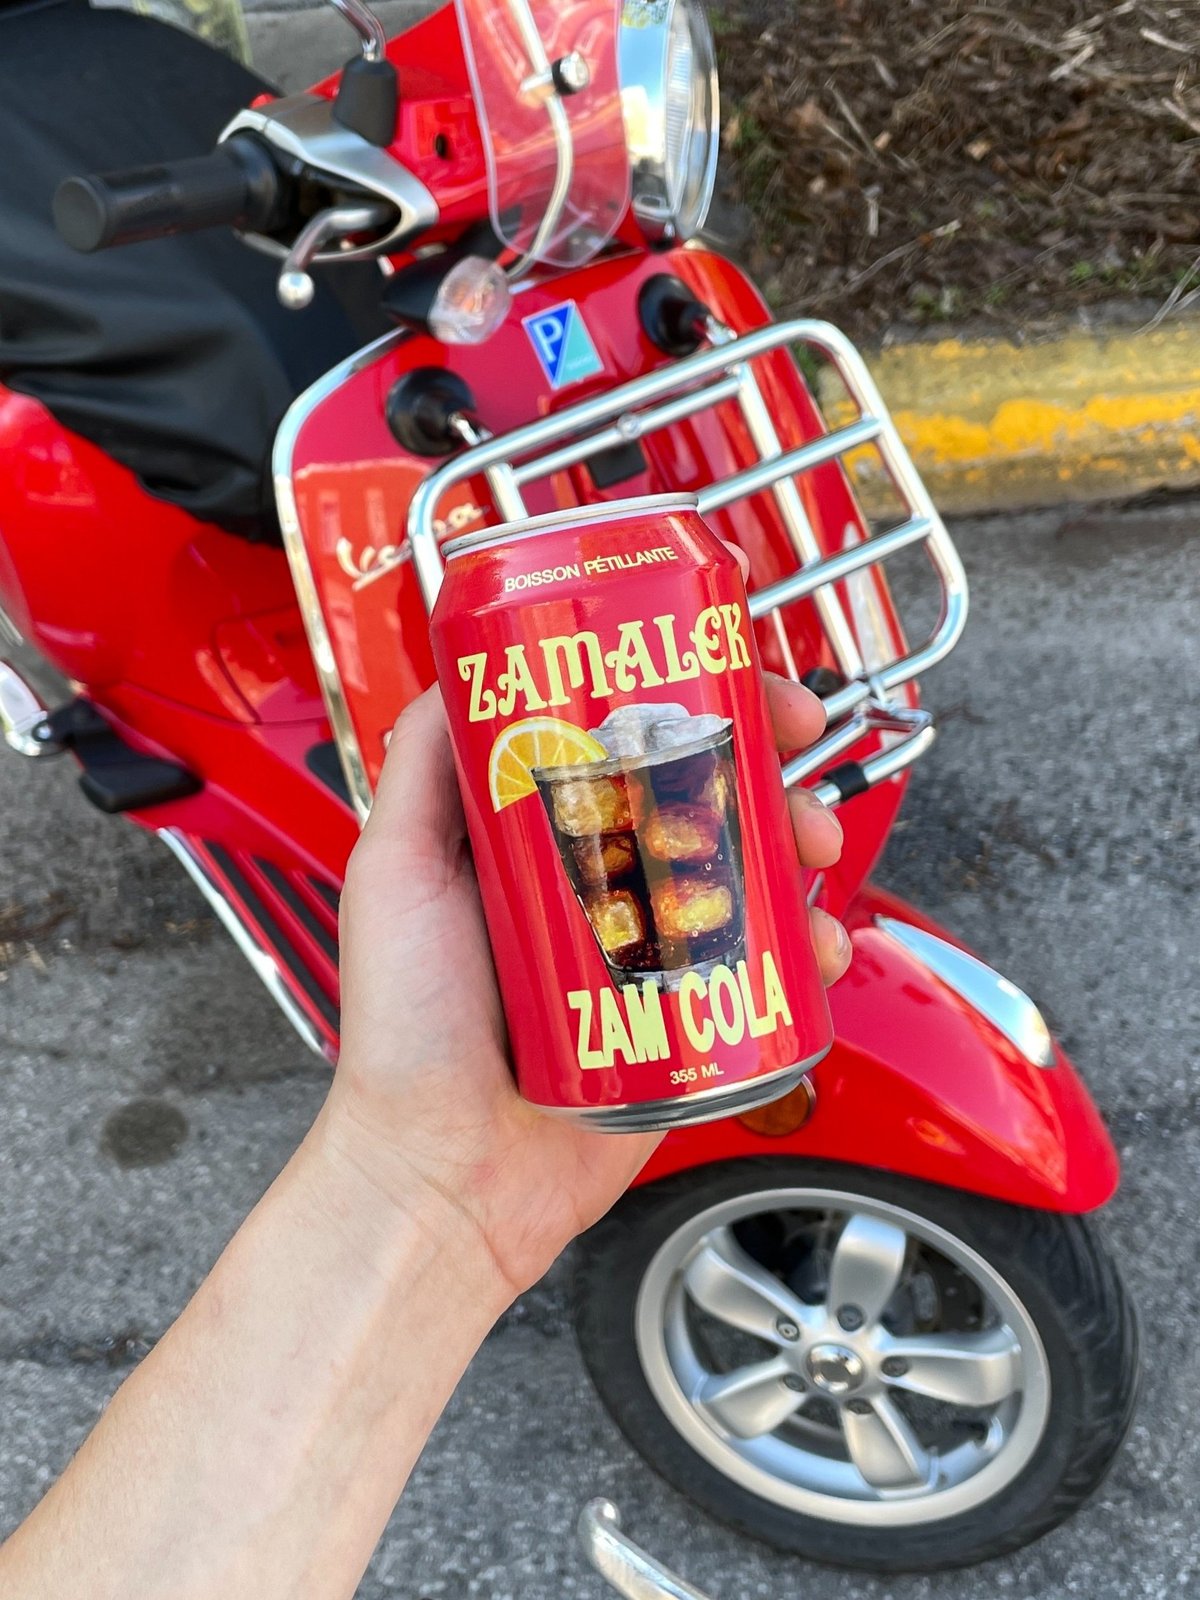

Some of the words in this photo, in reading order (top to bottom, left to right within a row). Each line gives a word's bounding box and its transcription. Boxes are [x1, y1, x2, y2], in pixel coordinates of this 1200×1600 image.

[533, 315, 564, 363] P
[504, 562, 580, 593] BOISSON
[583, 545, 679, 577] PÉTILLANTE
[456, 601, 752, 723] ZAMALEK
[566, 979, 671, 1071] ZAM
[678, 950, 794, 1054] COLA
[669, 1067, 698, 1085] 355
[701, 1061, 725, 1078] ML
